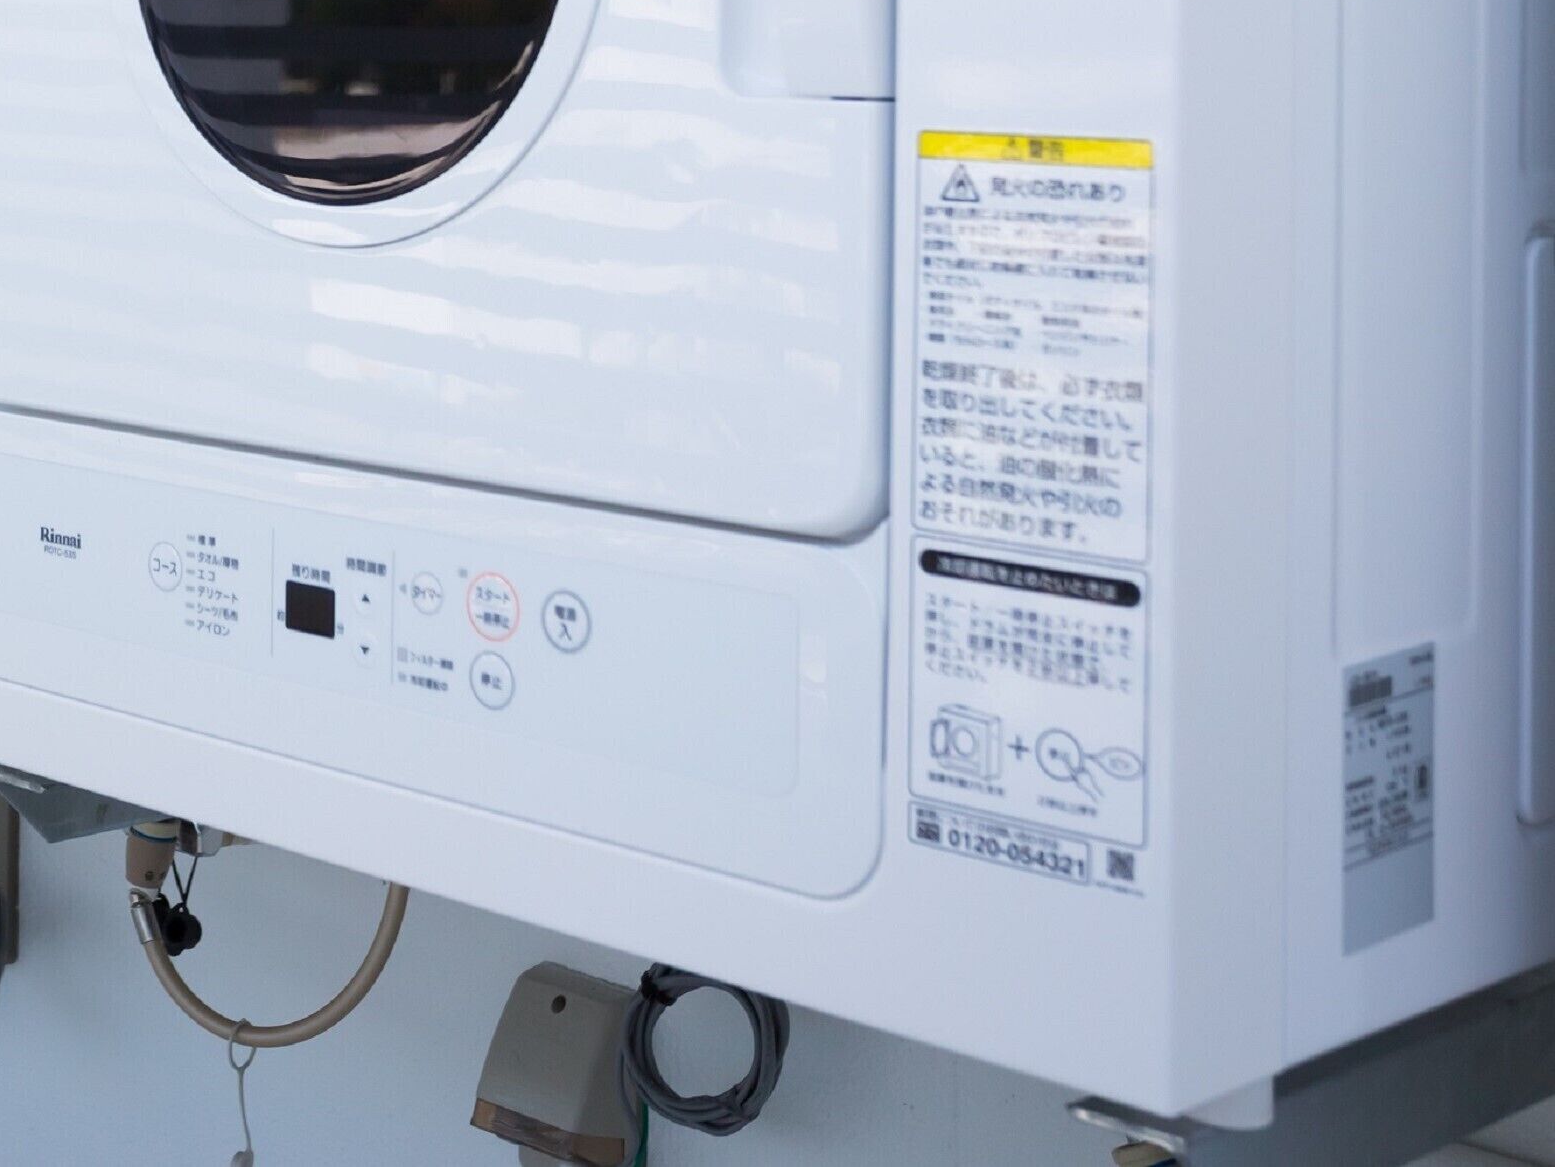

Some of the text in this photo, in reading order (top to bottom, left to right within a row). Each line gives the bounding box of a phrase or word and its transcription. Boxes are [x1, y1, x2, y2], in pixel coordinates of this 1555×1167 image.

[40, 526, 81, 550] Rinnai
[152, 556, 177, 575] コース
[196, 568, 215, 581] エコ
[291, 562, 330, 584] 残り時間
[197, 585, 239, 604] デリケート
[475, 585, 510, 605] スタート
[196, 619, 230, 636] アイロン
[558, 623, 572, 642] 入
[481, 672, 501, 690] 停止
[948, 827, 1084, 878] 0120-054321
